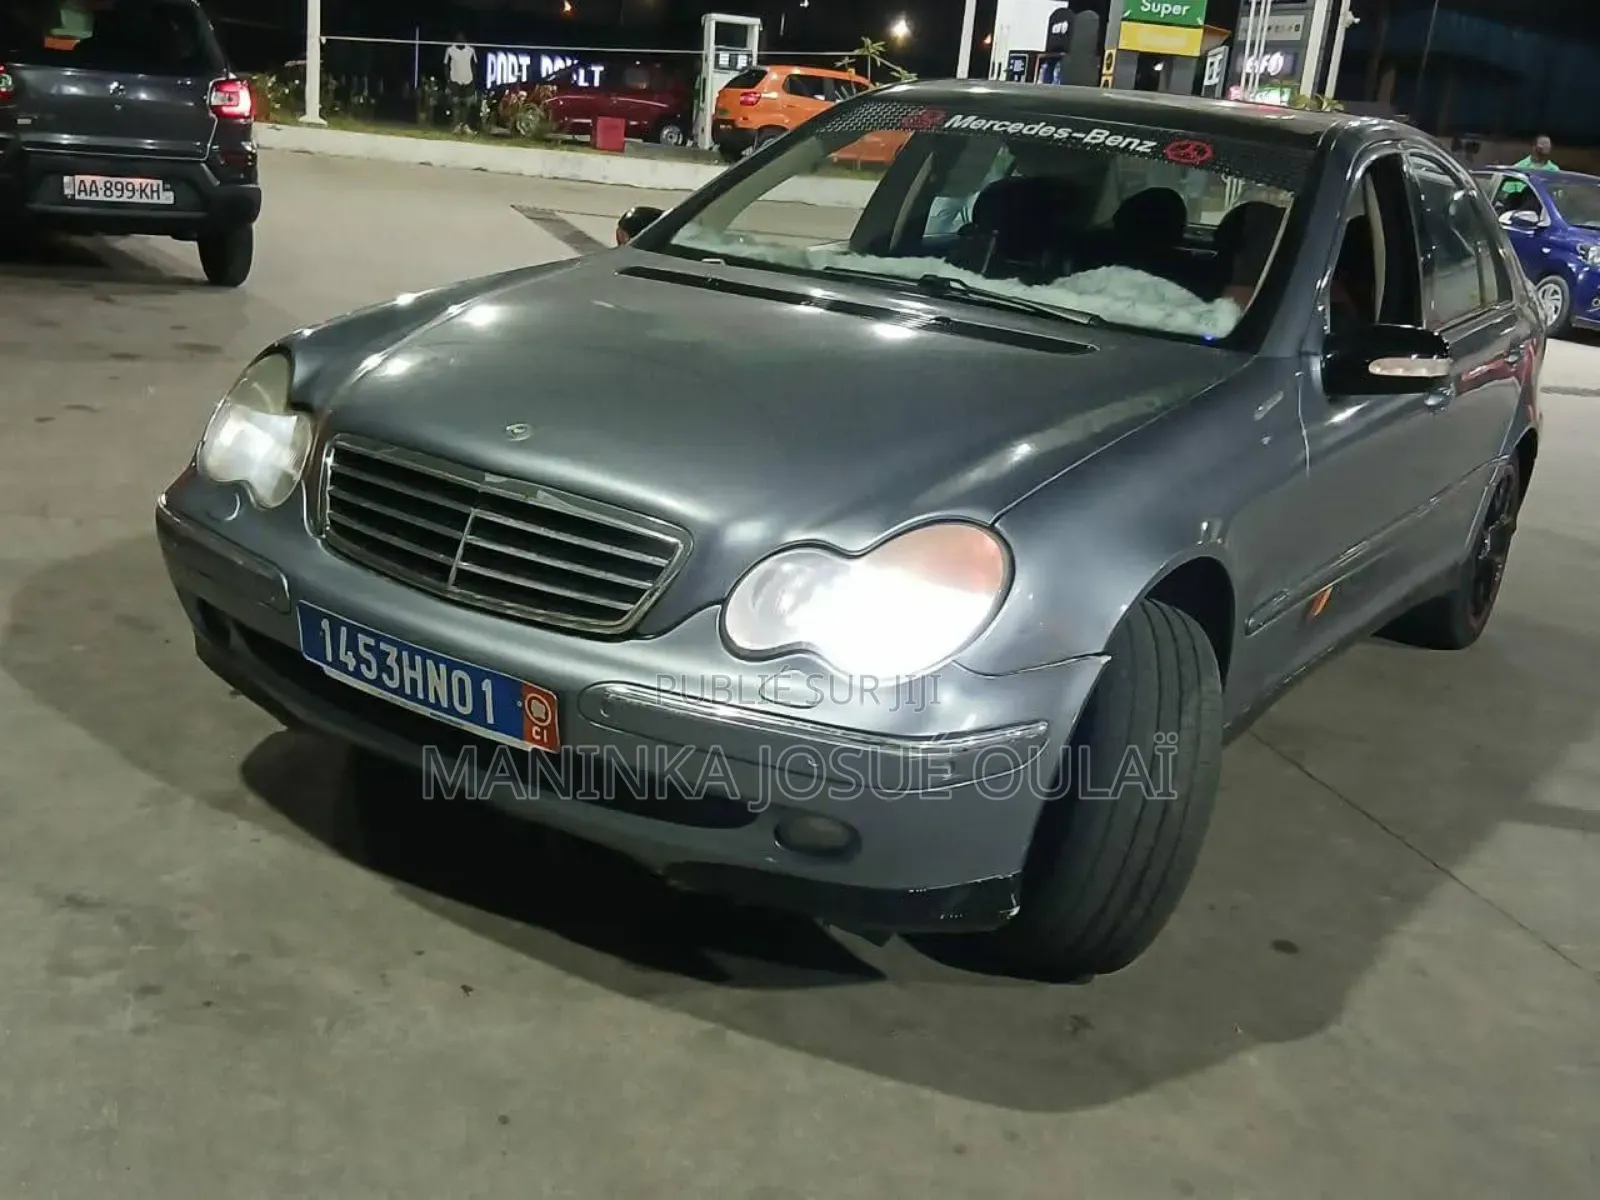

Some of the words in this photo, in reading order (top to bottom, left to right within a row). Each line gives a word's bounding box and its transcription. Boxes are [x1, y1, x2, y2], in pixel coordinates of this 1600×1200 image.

[1140, 0, 1191, 18] Super
[944, 114, 1157, 153] Mercedes-Benz
[531, 725, 549, 744] CI
